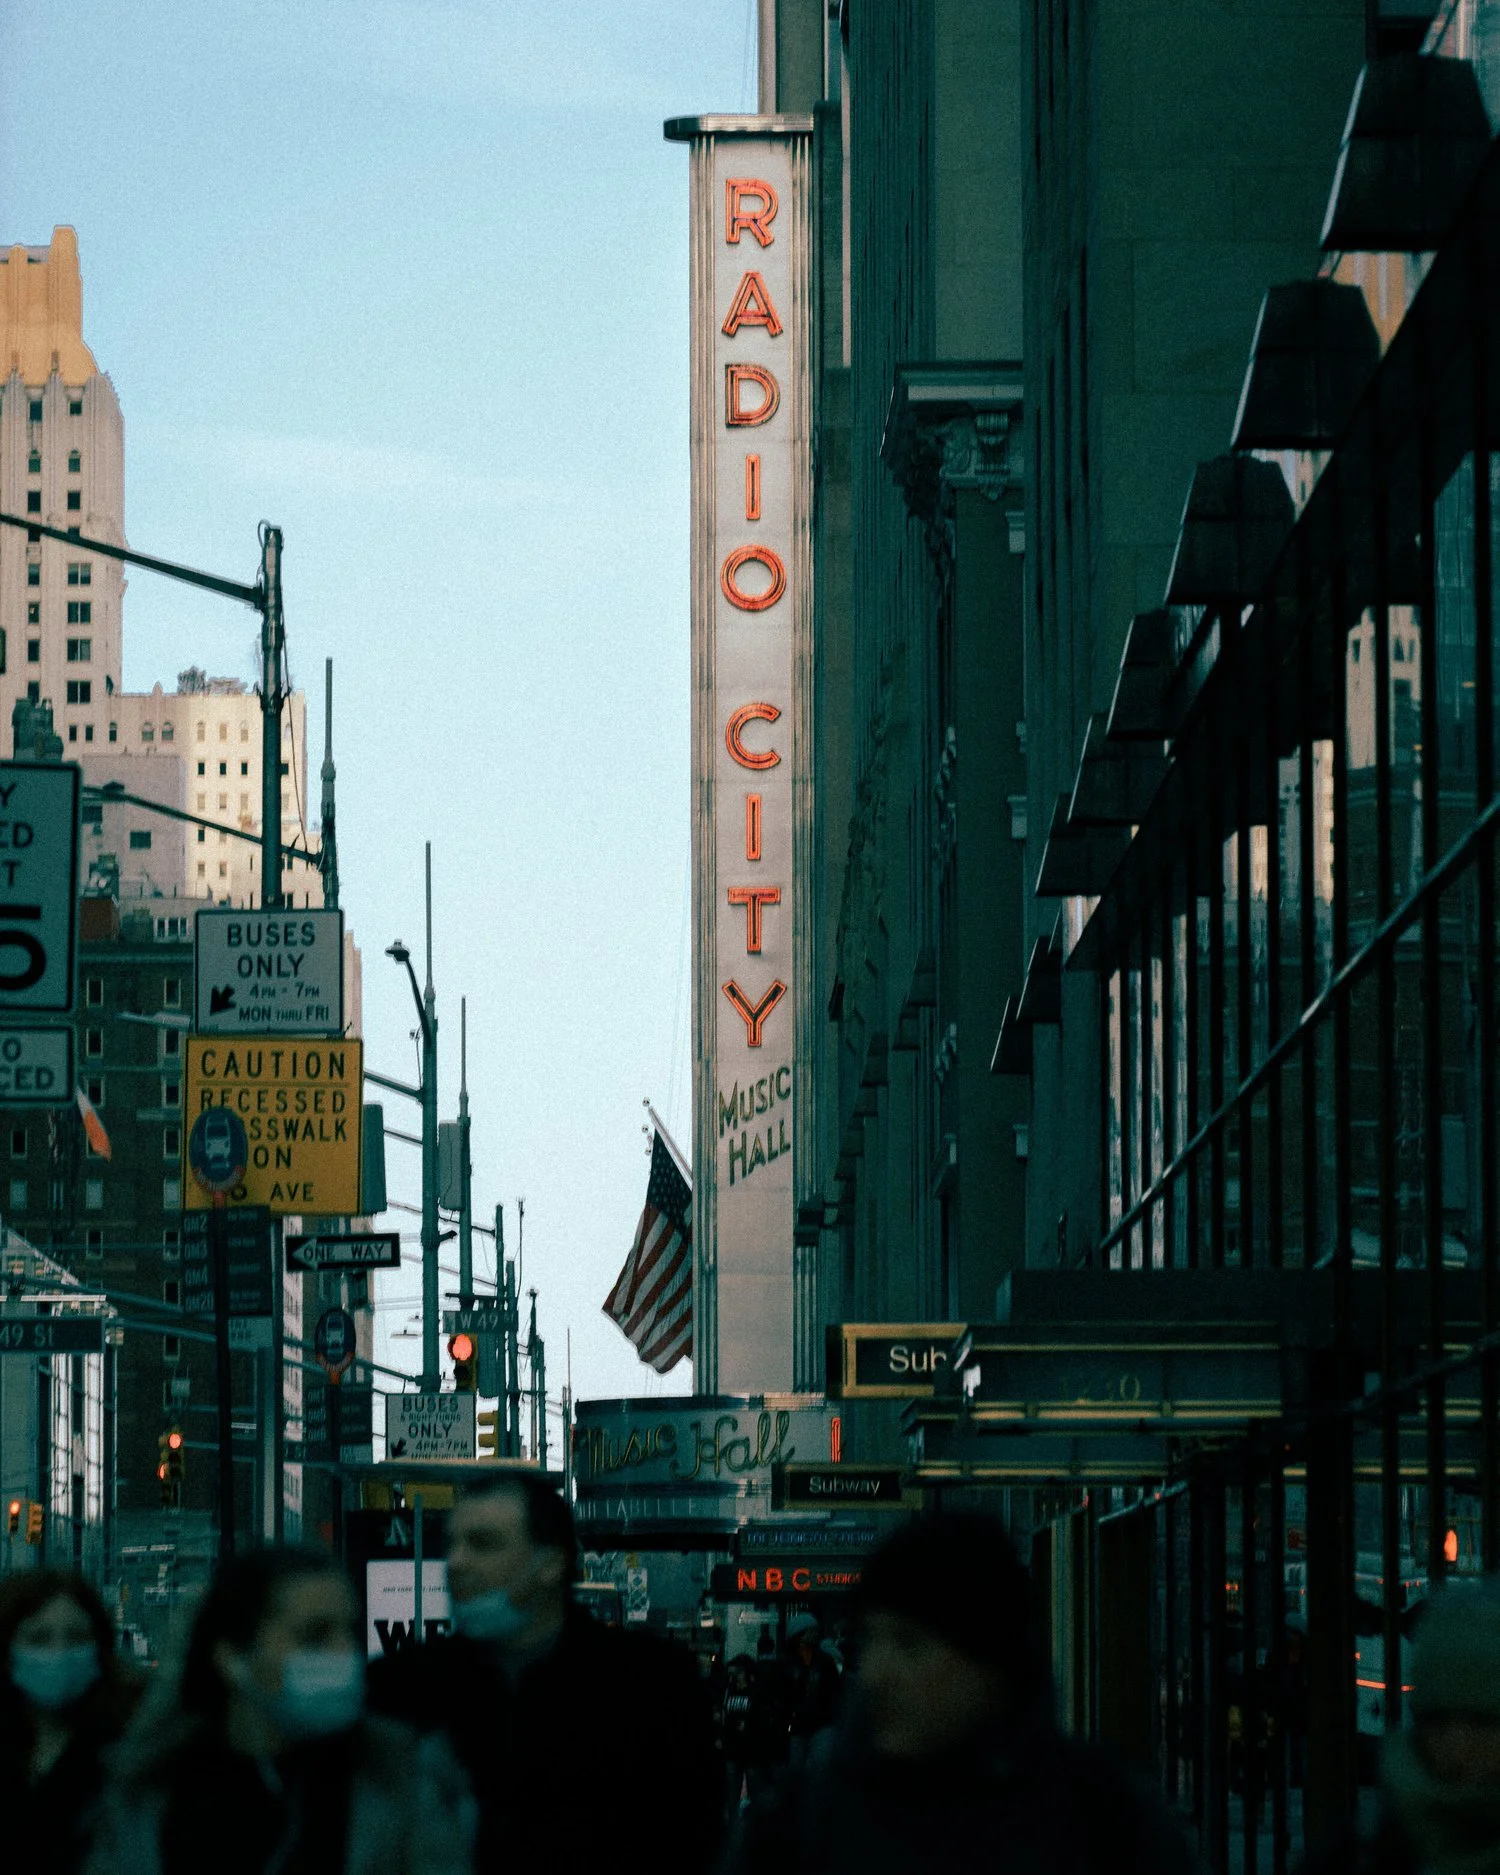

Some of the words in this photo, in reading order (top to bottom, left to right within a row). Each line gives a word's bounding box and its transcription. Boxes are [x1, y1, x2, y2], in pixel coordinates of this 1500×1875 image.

[720, 178, 787, 612] RADIO
[721, 702, 787, 1047] CITY
[227, 921, 316, 948] BUSES
[237, 953, 305, 978] ONLY
[239, 1005, 272, 1022] MON
[306, 1004, 329, 1020] FRI
[201, 1050, 345, 1079] CAUTION
[201, 1087, 346, 1114] RECESSED
[719, 1066, 791, 1138] MUSIC
[249, 1116, 347, 1142] SSWALK
[253, 1145, 292, 1169] ON
[728, 1119, 791, 1187] HALL
[270, 1182, 315, 1202] AVE
[303, 1243, 336, 1261] ONE
[351, 1242, 385, 1260] WAY
[460, 1312, 472, 1329] W
[477, 1312, 499, 1330] 49
[34, 1322, 54, 1348] St
[889, 1344, 947, 1373] Sub
[402, 1394, 459, 1412] BUSES
[408, 1422, 452, 1438] ONLY
[580, 1422, 678, 1480] Music
[670, 1410, 797, 1481] Hall
[809, 1476, 881, 1496] Subway
[737, 1567, 812, 1592] NBC
